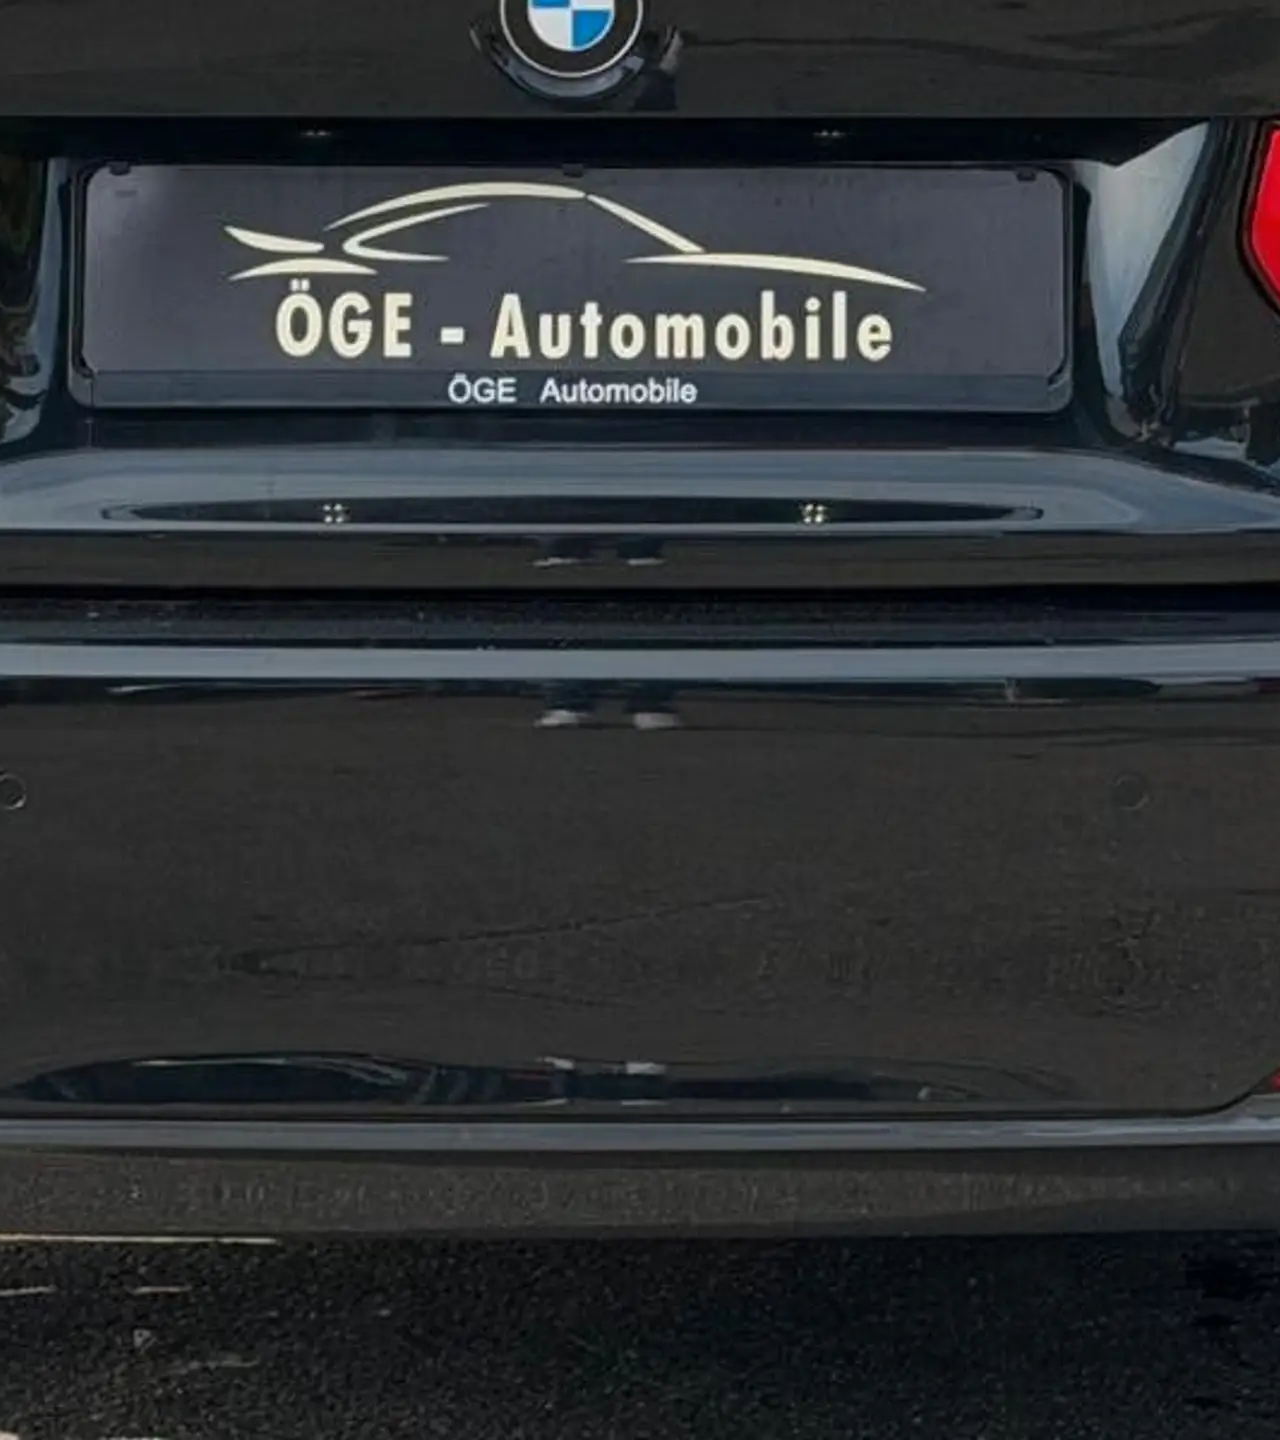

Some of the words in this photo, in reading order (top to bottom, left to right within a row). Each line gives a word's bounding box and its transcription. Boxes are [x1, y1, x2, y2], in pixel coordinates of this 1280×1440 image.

[275, 278, 413, 359] ÖGE
[489, 289, 893, 362] Automobile
[447, 373, 517, 404] ÖGE
[539, 377, 698, 404] Automobile
